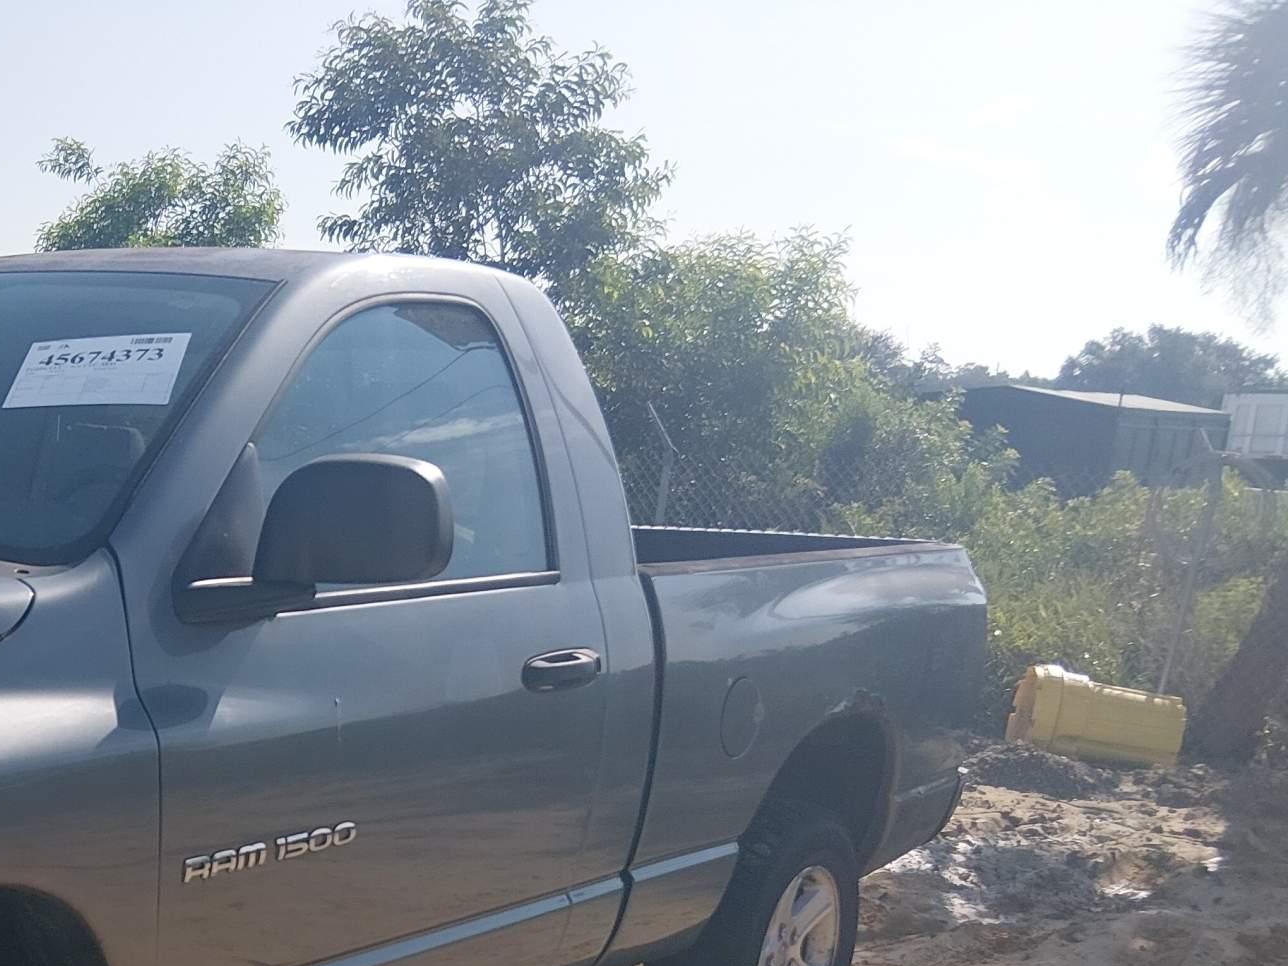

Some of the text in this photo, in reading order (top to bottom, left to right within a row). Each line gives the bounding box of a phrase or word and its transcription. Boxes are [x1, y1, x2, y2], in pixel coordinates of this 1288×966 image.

[38, 347, 165, 367] 45674373
[183, 820, 357, 884] RAM 1500
